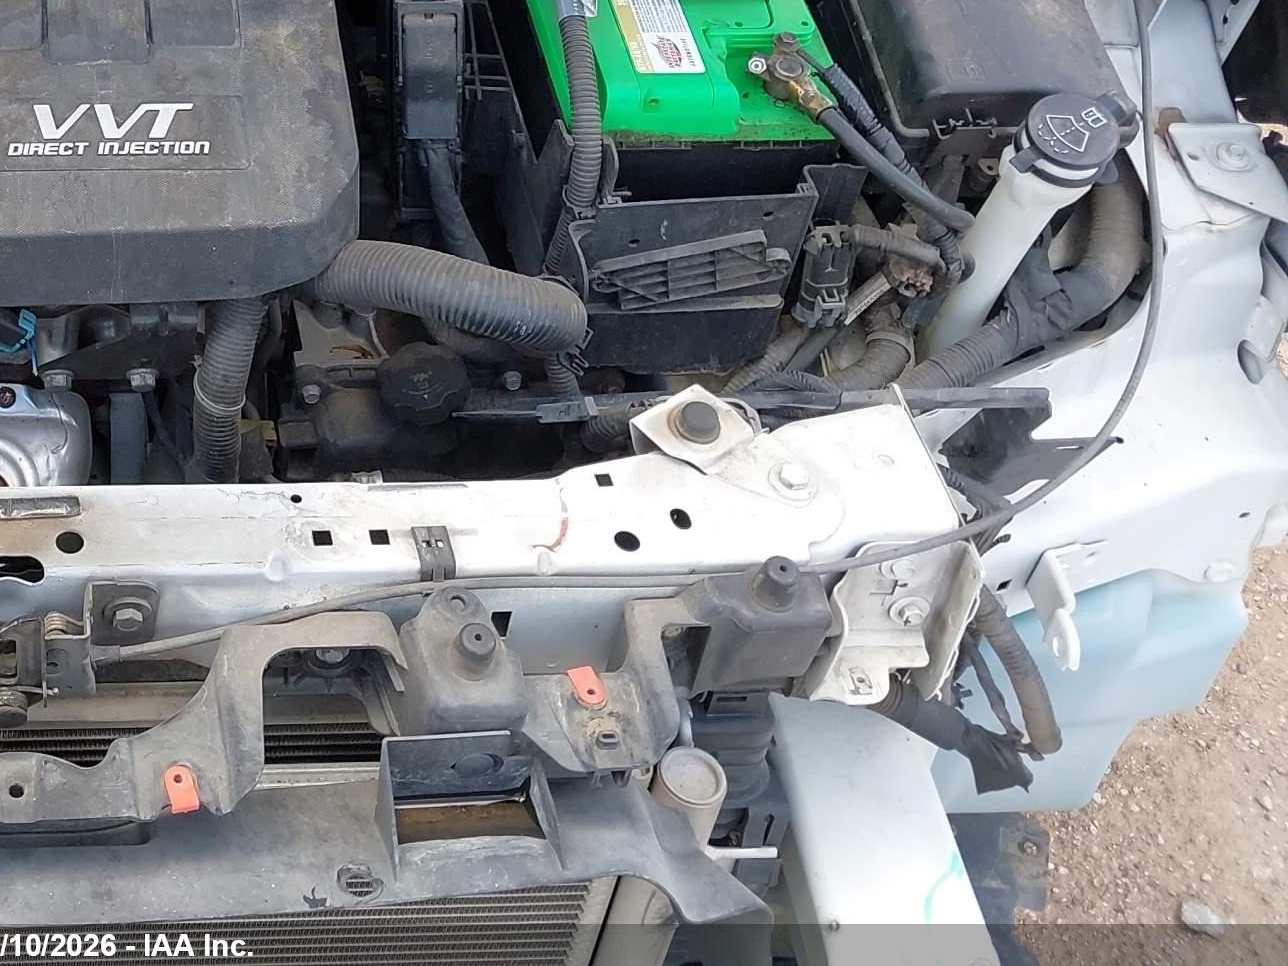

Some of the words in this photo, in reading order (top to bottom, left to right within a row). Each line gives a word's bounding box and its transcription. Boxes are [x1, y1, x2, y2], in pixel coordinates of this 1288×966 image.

[33, 103, 194, 139] VVT
[7, 141, 90, 156] DIRECT
[97, 141, 210, 156] INJECTION
